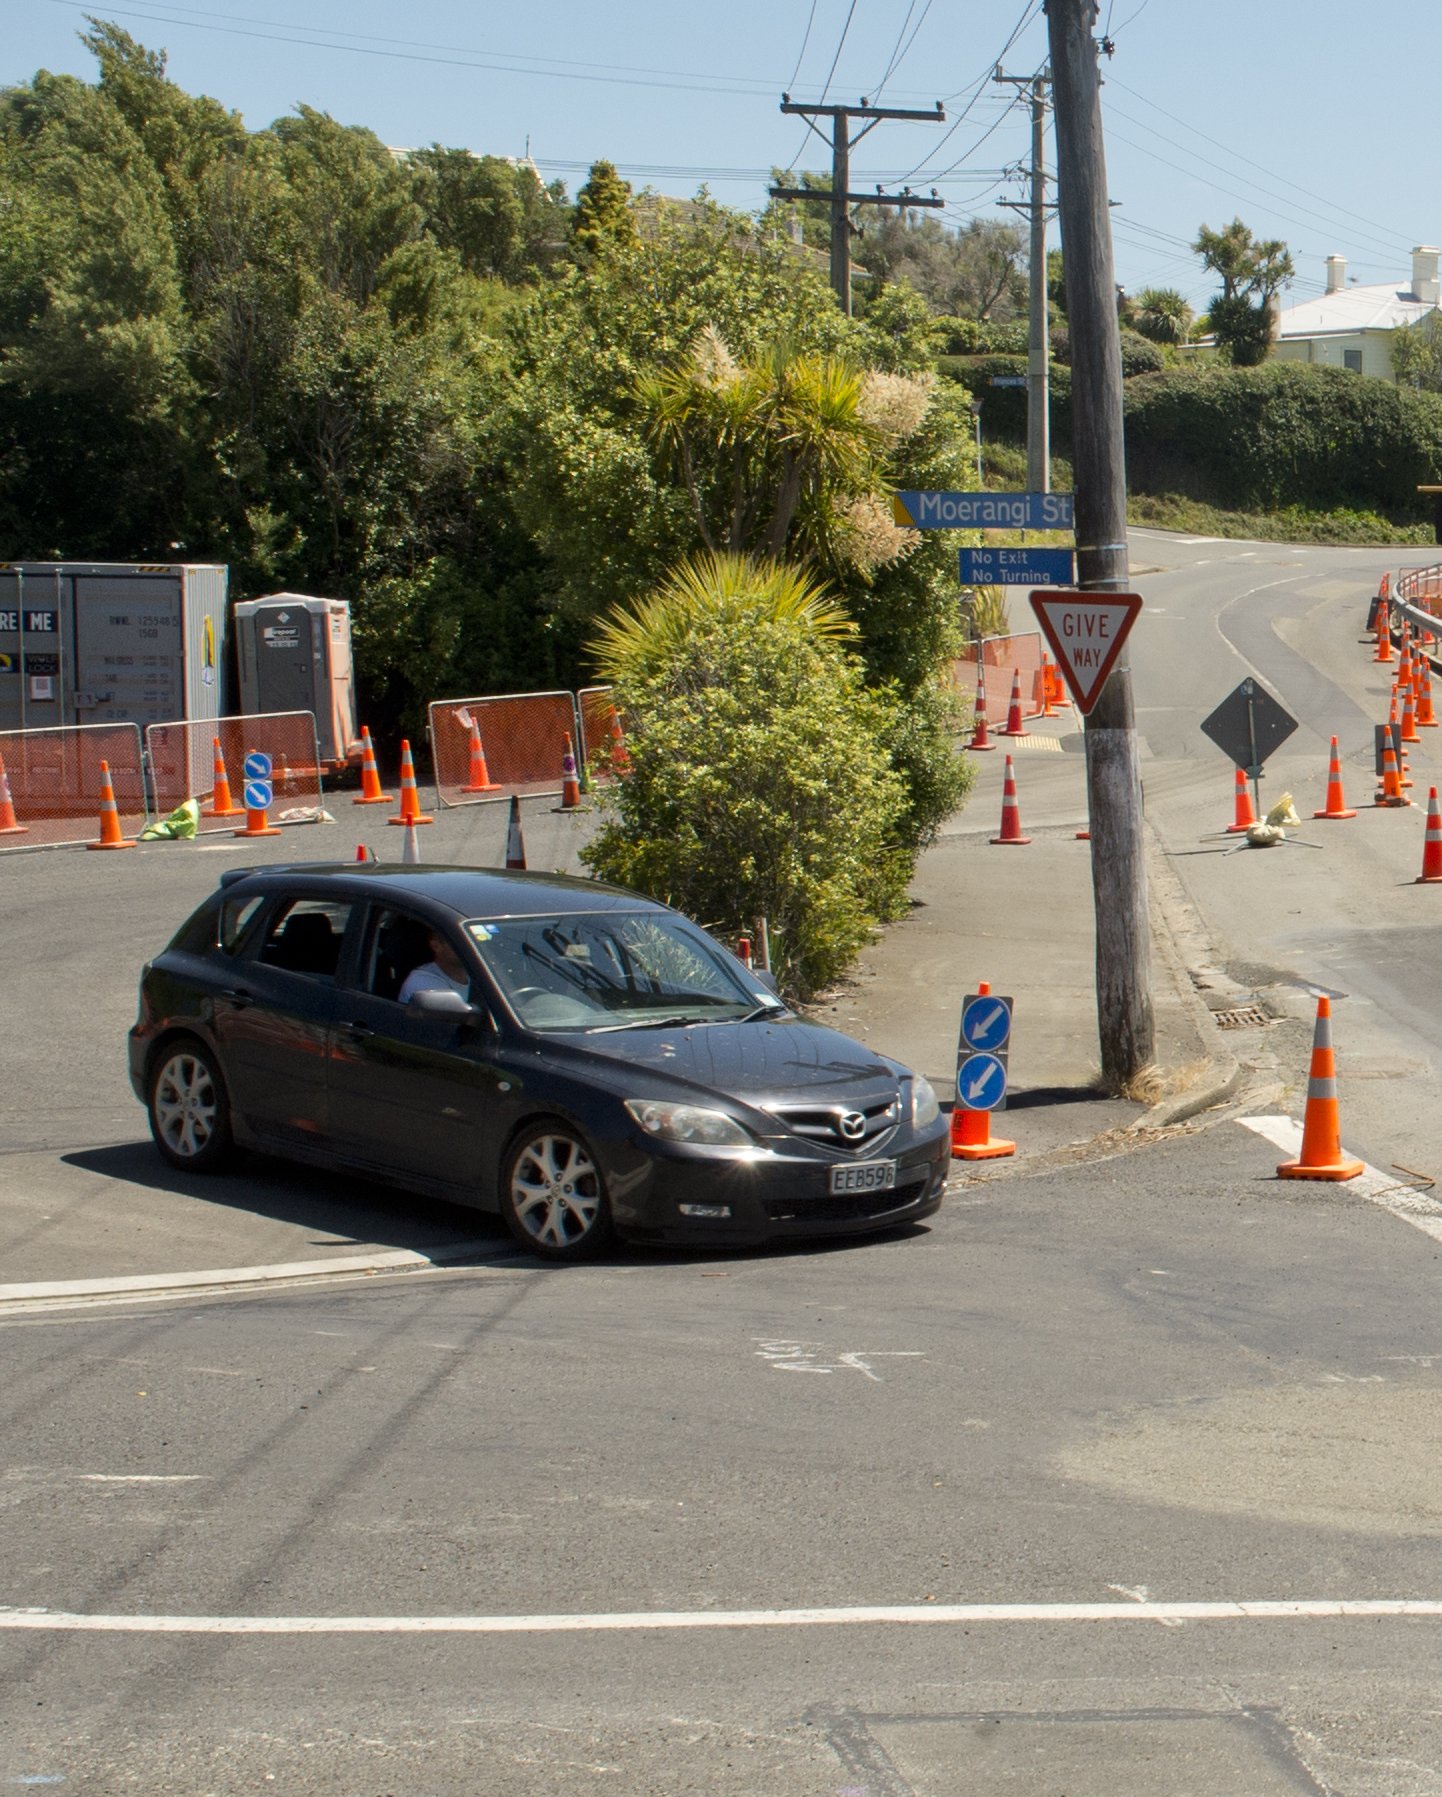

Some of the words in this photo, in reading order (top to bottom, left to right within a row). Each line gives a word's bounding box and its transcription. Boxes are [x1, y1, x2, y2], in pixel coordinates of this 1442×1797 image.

[919, 493, 1031, 527] Moerangi
[1042, 495, 1070, 523] St
[971, 550, 993, 565] No
[998, 550, 1028, 565] Exit
[972, 569, 994, 583] No
[1000, 568, 1051, 585] Turning
[31, 612, 52, 631] ME
[1063, 613, 1109, 638] GIVE
[1073, 648, 1101, 667] WAY
